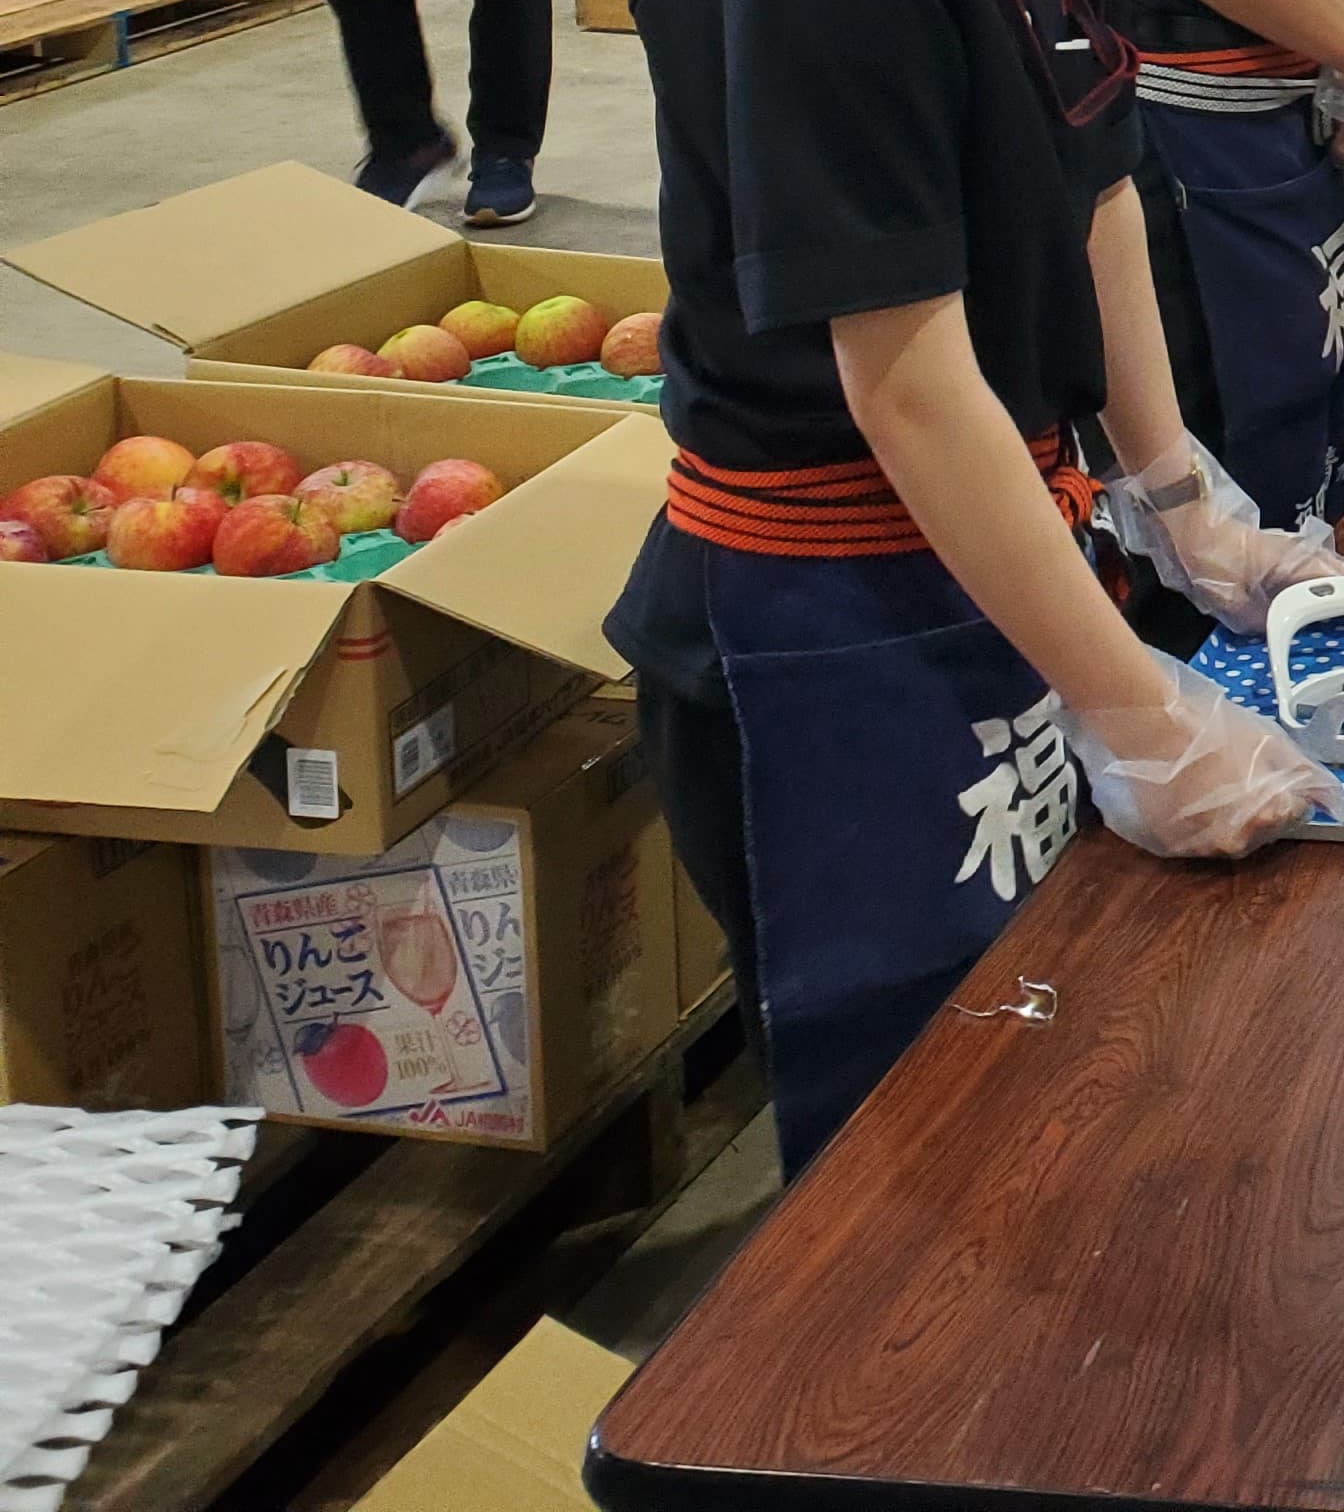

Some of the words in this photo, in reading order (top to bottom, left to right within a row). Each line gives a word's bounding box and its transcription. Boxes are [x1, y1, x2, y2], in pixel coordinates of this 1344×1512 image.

[954, 688, 1078, 902] 福
[260, 920, 367, 975] りんご
[275, 968, 385, 1016] ジュース
